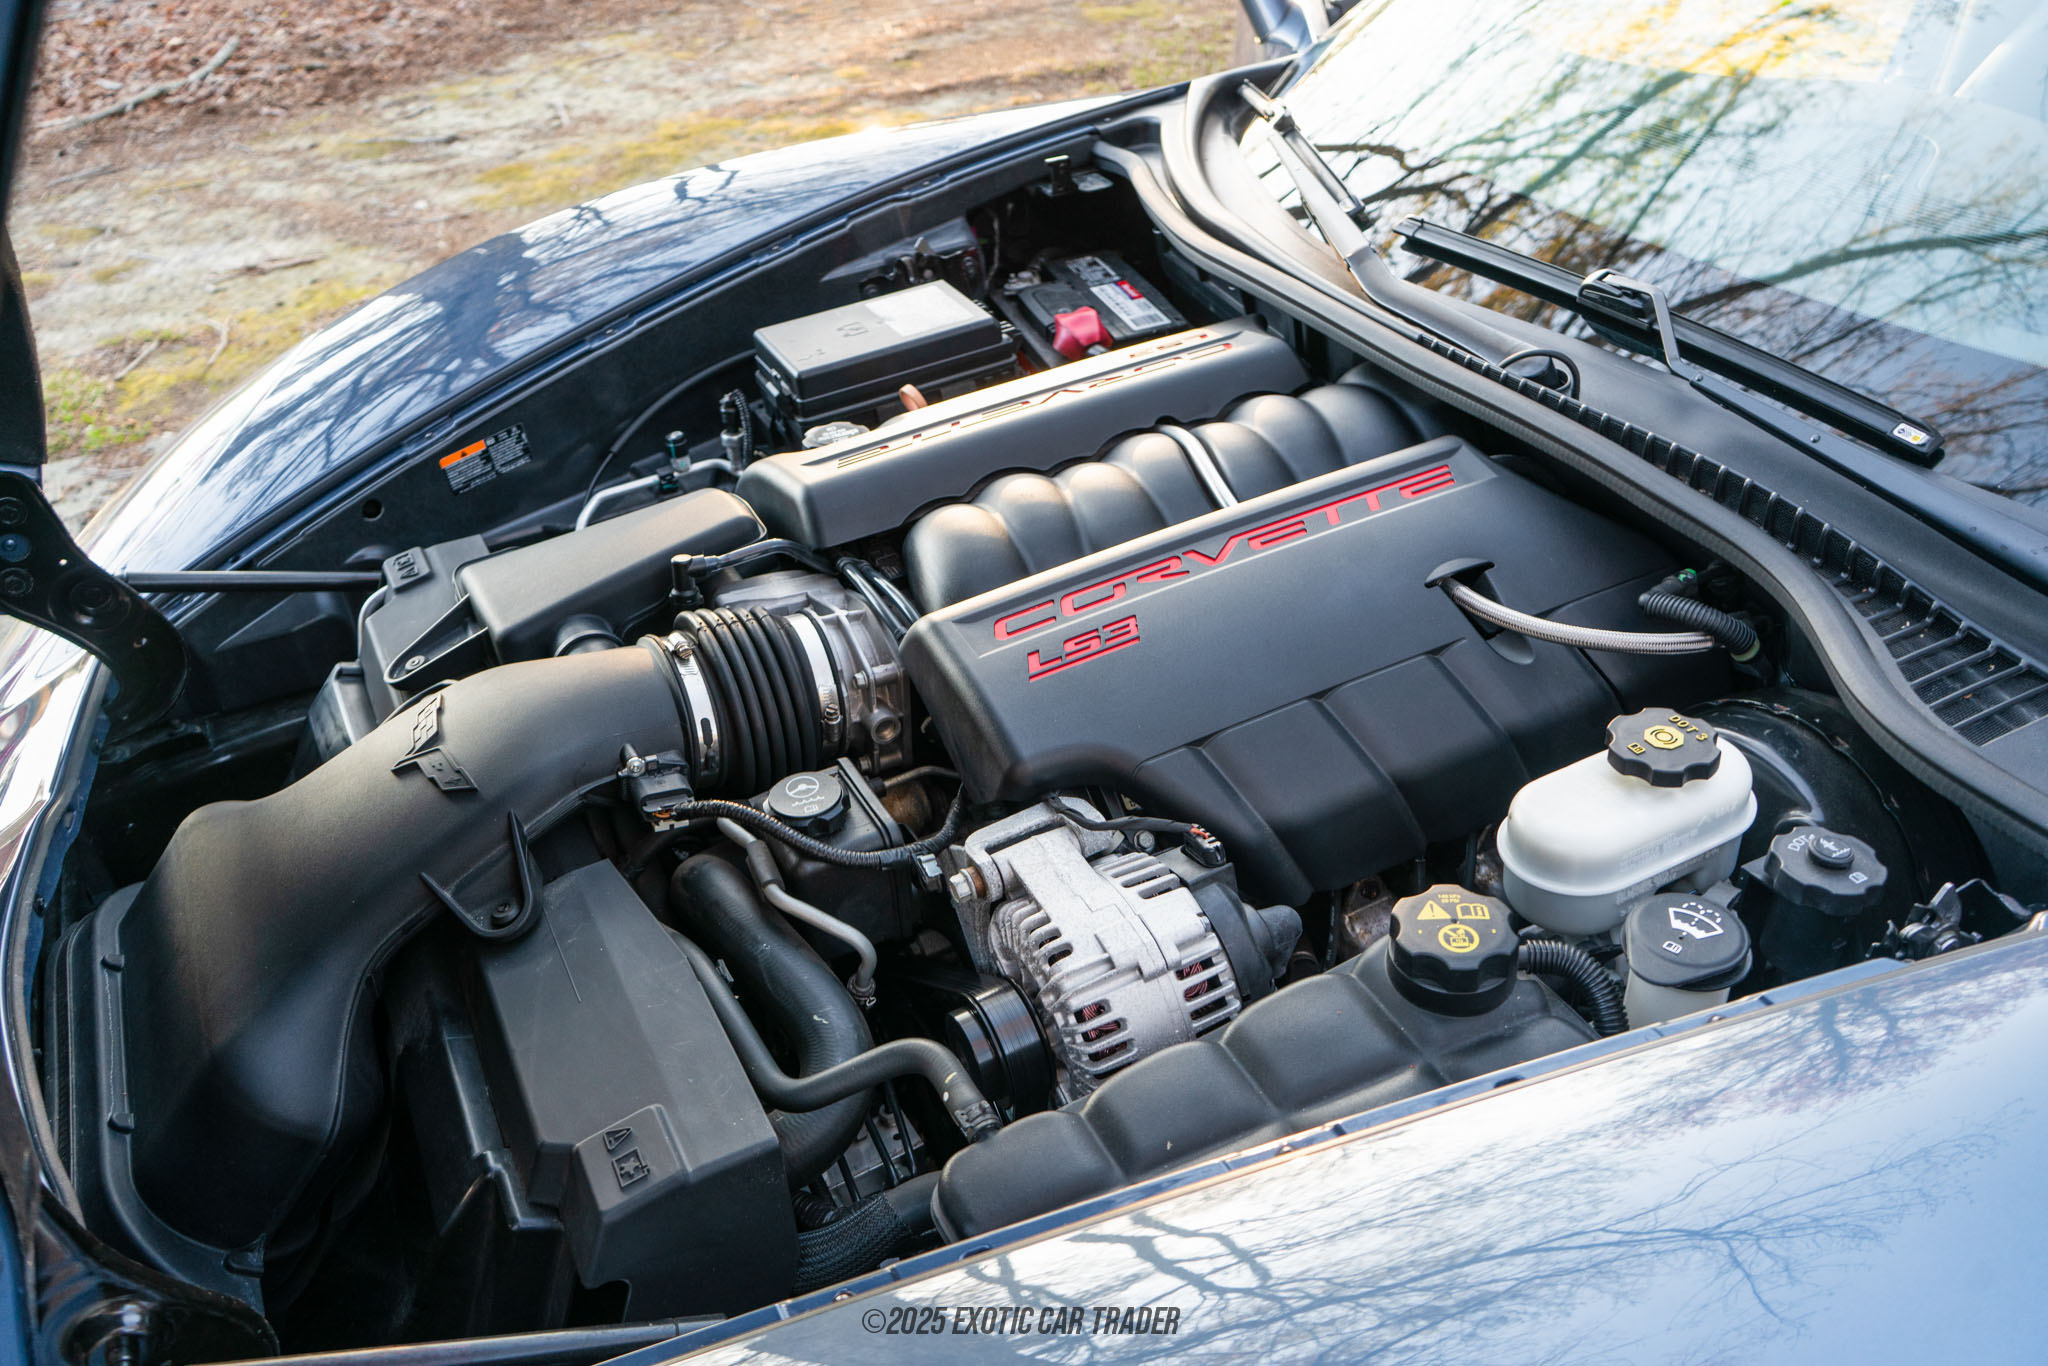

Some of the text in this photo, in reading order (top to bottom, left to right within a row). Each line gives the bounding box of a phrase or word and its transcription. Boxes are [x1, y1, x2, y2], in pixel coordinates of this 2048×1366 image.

[993, 464, 1456, 641] CORVETTE
[1027, 614, 1140, 675] LS3
[1668, 714, 1708, 742] DOT 3
[1787, 834, 1809, 852] DOT
